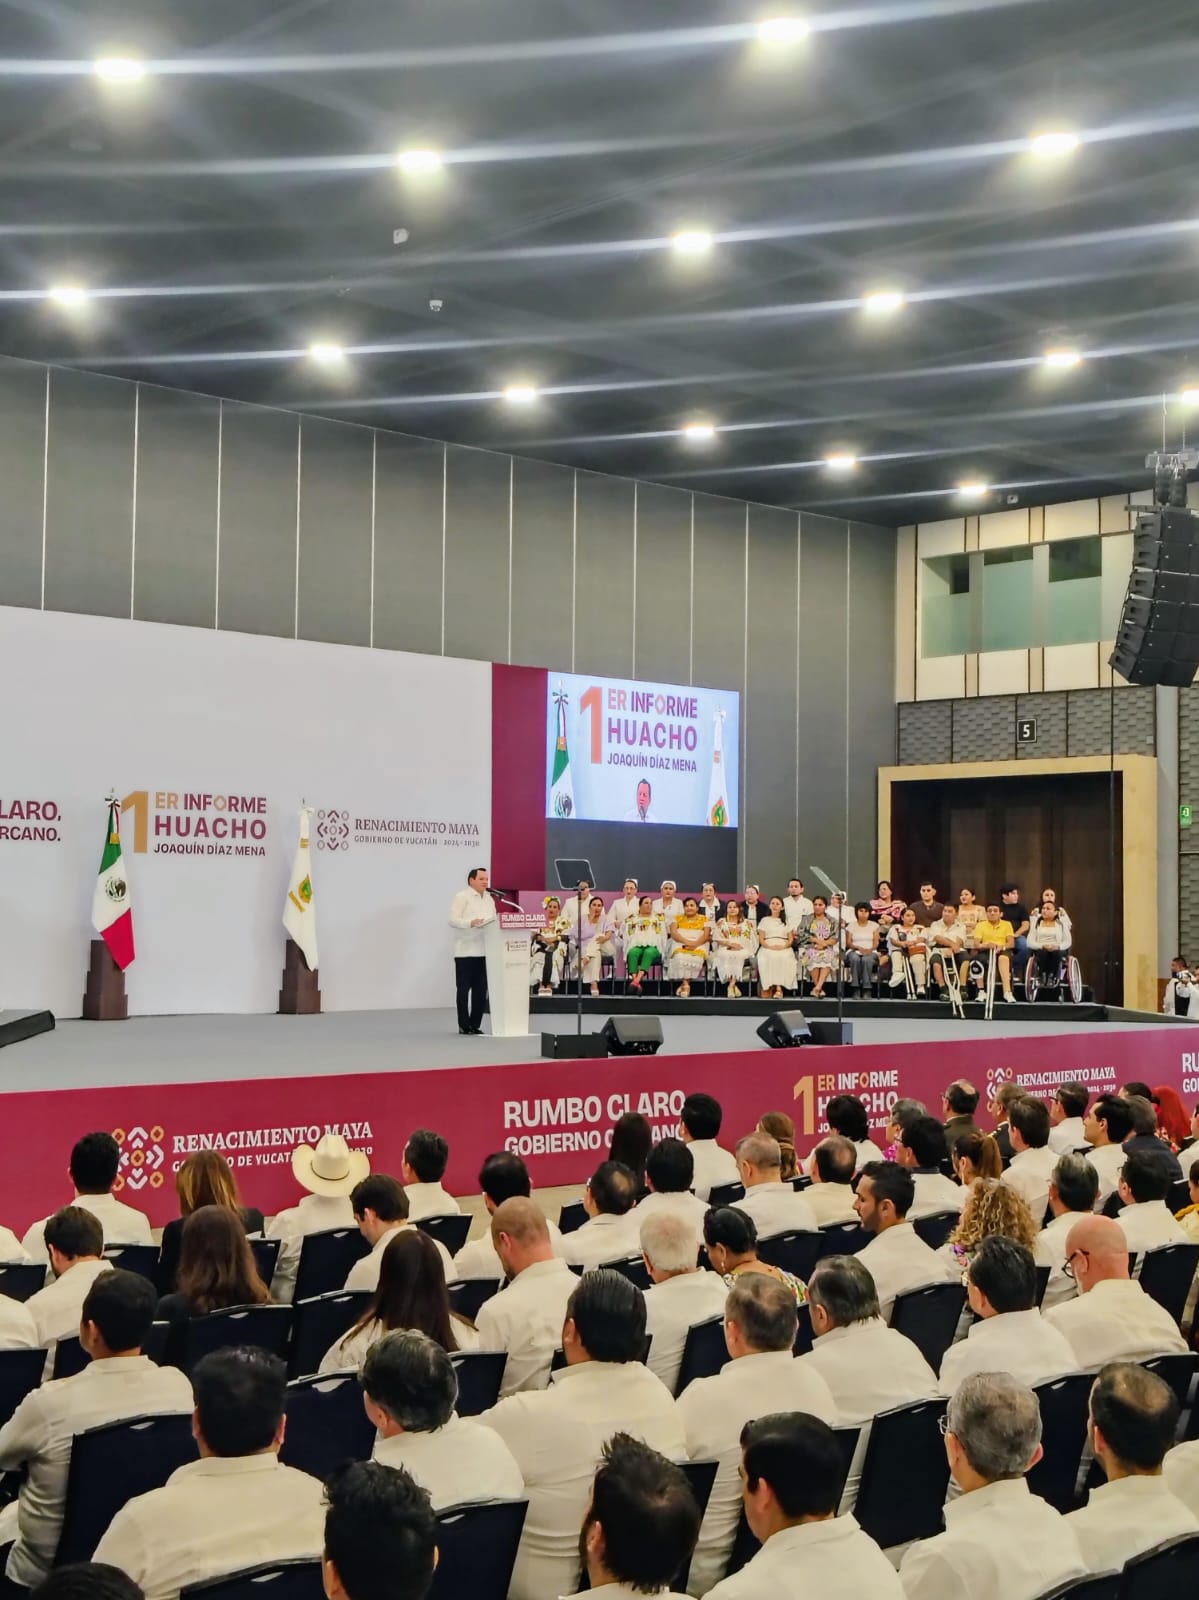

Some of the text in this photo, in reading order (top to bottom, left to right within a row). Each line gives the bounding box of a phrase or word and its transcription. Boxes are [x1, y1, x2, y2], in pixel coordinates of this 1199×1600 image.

[580, 686, 698, 765] 1 ER INFORME
[607, 717, 698, 752] HUACHO
[1023, 724, 1030, 738] 5
[607, 751, 697, 773] JOAQUÍN DÍAZ MENA
[121, 790, 267, 854] 1 ER INFORME
[154, 815, 267, 840] HUACHO
[355, 818, 480, 836] RENACIMIENTO MAYA
[154, 841, 266, 857] JOAQUÍN DÍAZ MENA
[354, 834, 393, 845] GOBIERNO
[1016, 1066, 1116, 1087] RENACIMIENTO MAYA
[503, 1095, 602, 1129] RUMBO
[793, 1075, 814, 1136] 1
[818, 1074, 836, 1092] ER
[838, 1070, 899, 1090] INFORME
[818, 1091, 899, 1117] HCHO
[172, 1121, 374, 1153] RENACIMIENTO MAYA
[504, 1129, 602, 1156] GOBIERNO
[237, 1154, 253, 1167] DE
[255, 1151, 292, 1166] YUCAT
